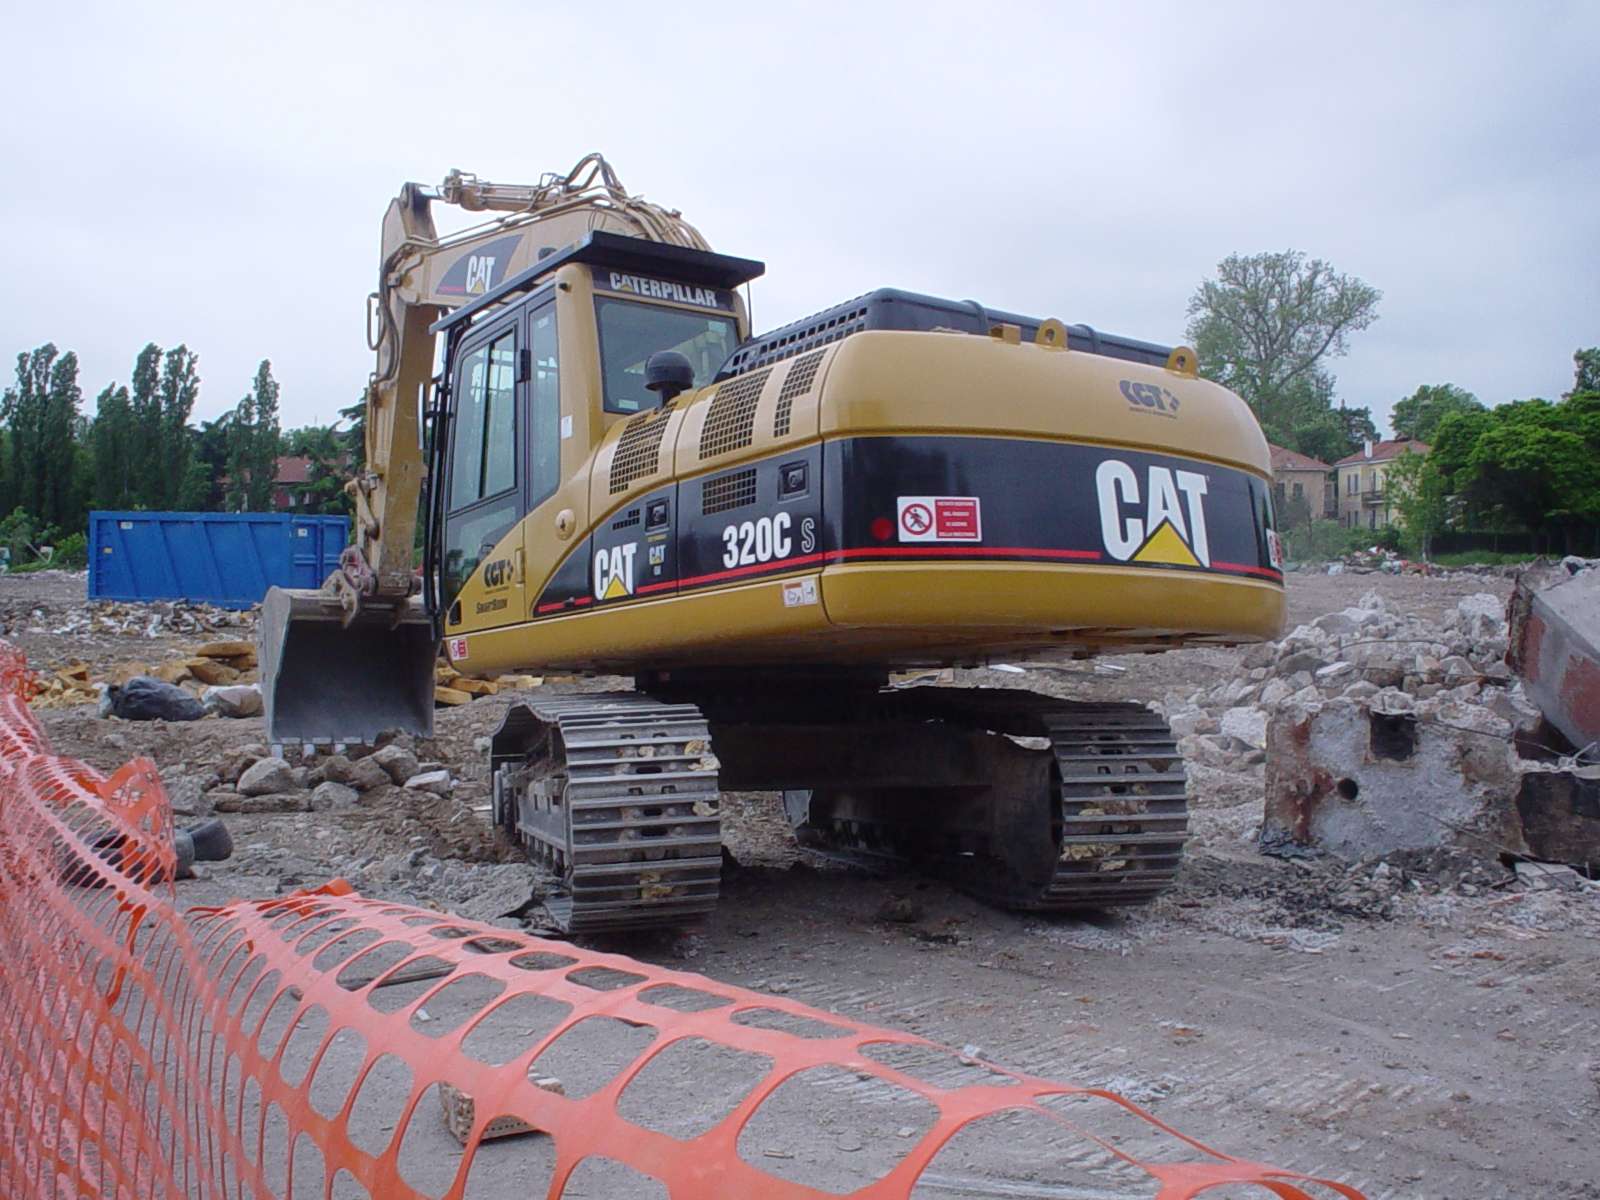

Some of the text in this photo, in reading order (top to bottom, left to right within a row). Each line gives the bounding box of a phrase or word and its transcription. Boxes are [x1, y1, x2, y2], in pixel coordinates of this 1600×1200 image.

[466, 255, 496, 294] CAT
[609, 271, 718, 308] CATERPILLAR
[1095, 458, 1210, 569] CAT
[649, 544, 666, 565] CAT
[722, 511, 816, 569] 320C S
[594, 542, 638, 601] CAT
